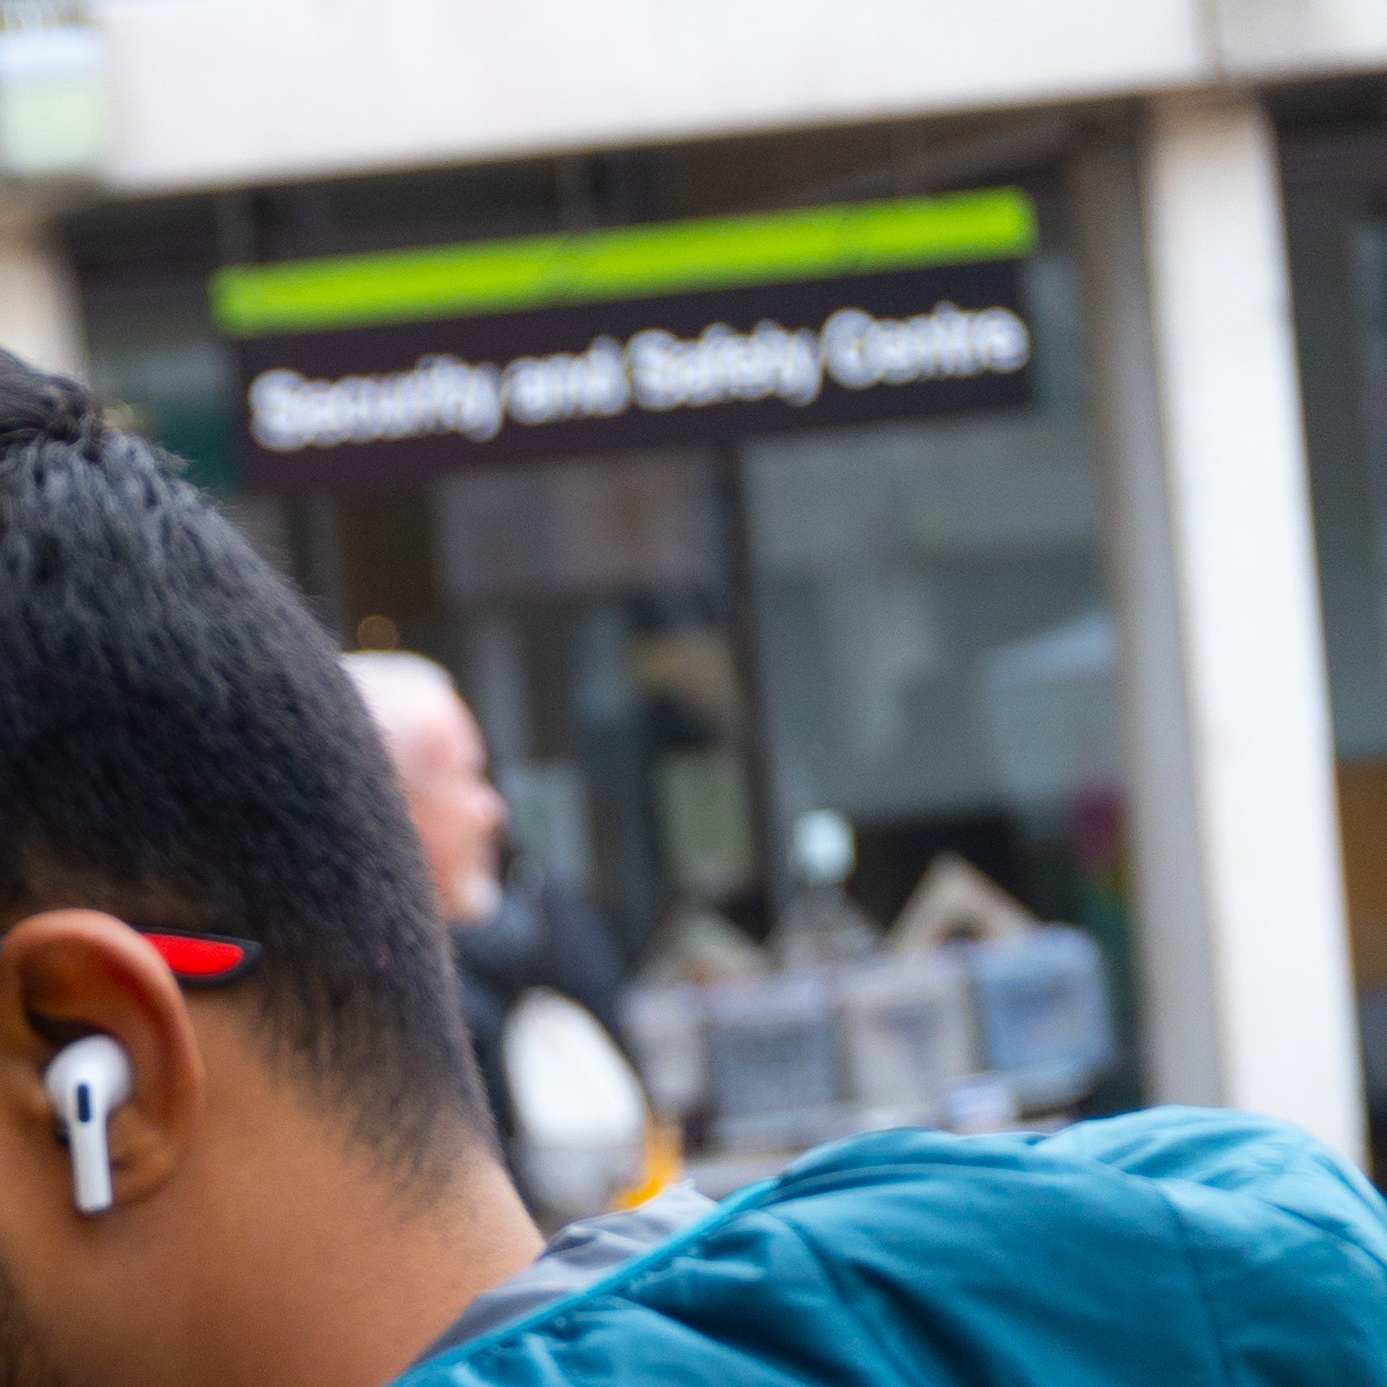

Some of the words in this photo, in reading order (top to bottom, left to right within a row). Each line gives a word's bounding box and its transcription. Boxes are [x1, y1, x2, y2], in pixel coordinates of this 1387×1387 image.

[249, 354, 503, 451] Security
[505, 335, 629, 423] and
[629, 320, 824, 408] Safety
[822, 301, 1029, 389] Centre
